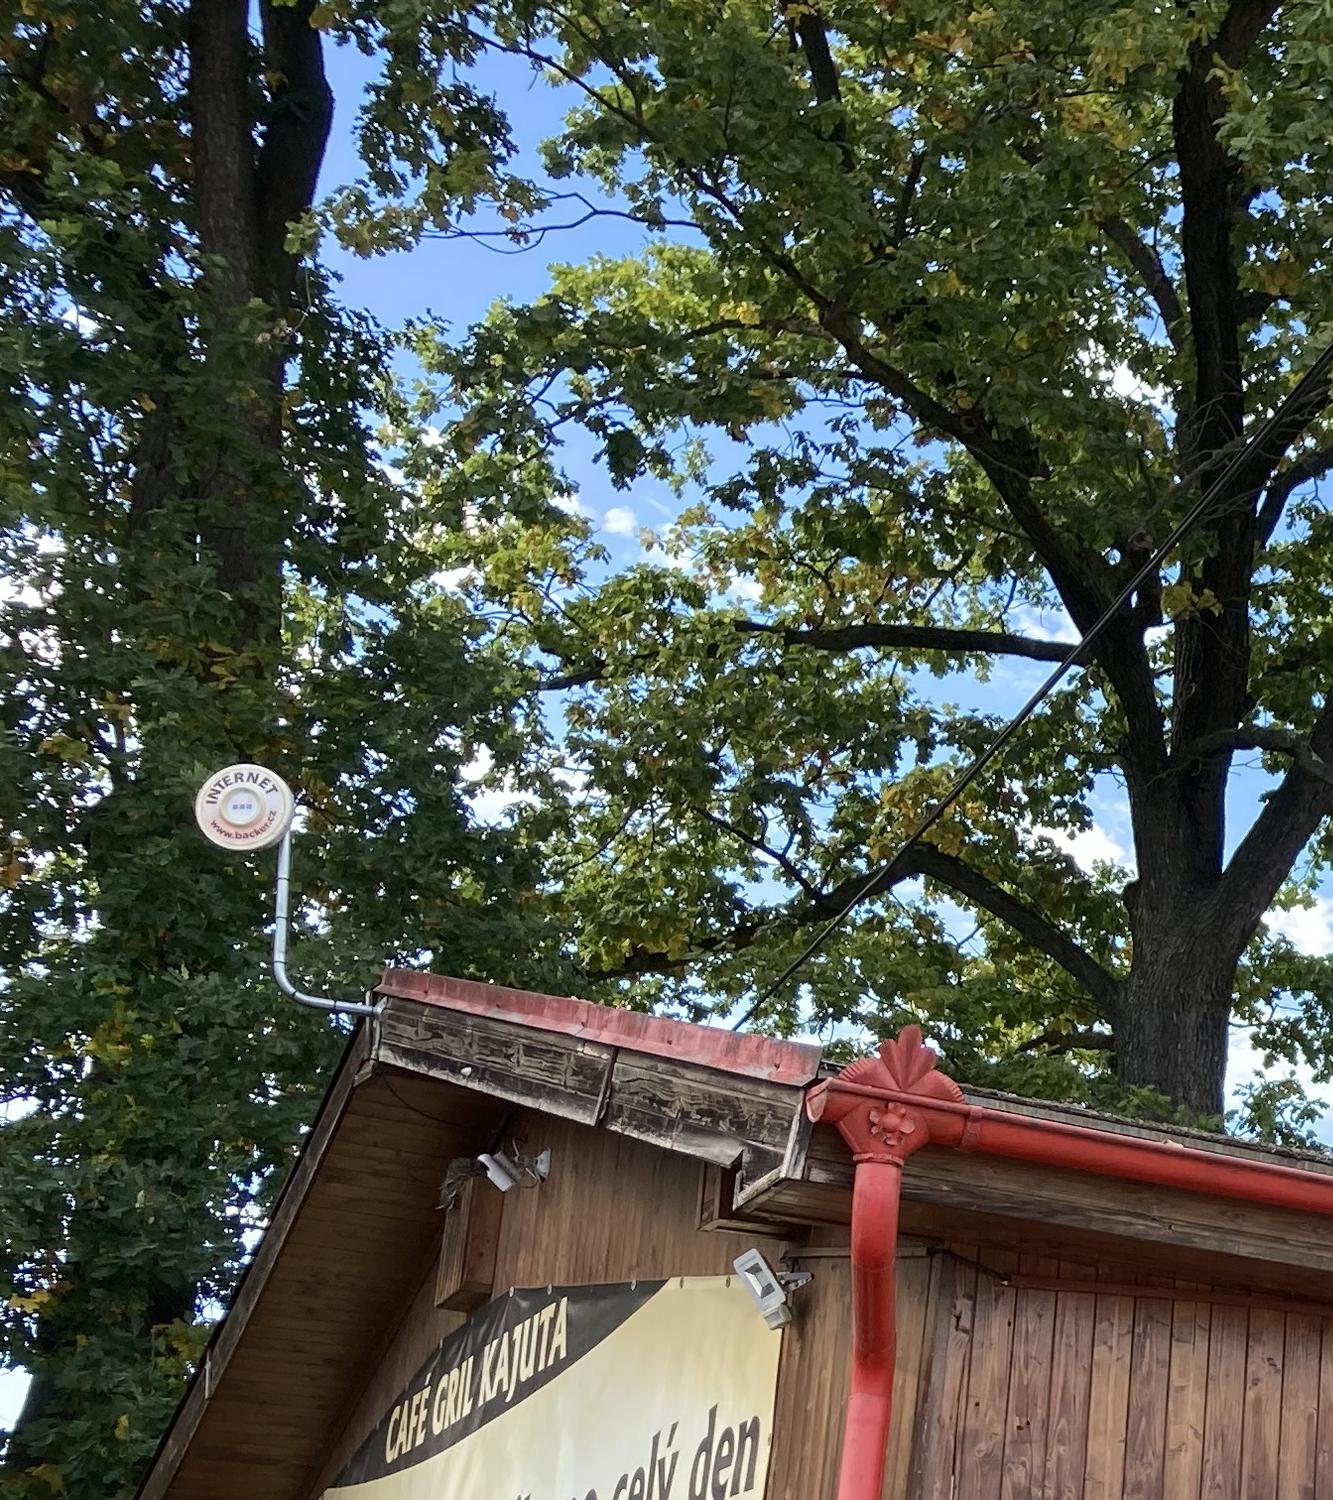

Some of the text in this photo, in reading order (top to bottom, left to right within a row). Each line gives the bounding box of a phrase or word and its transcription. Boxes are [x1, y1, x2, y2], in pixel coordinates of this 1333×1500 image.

[205, 771, 279, 805] INTERNET
[385, 1296, 568, 1464] CAFÉ GRIL KAJUTA
